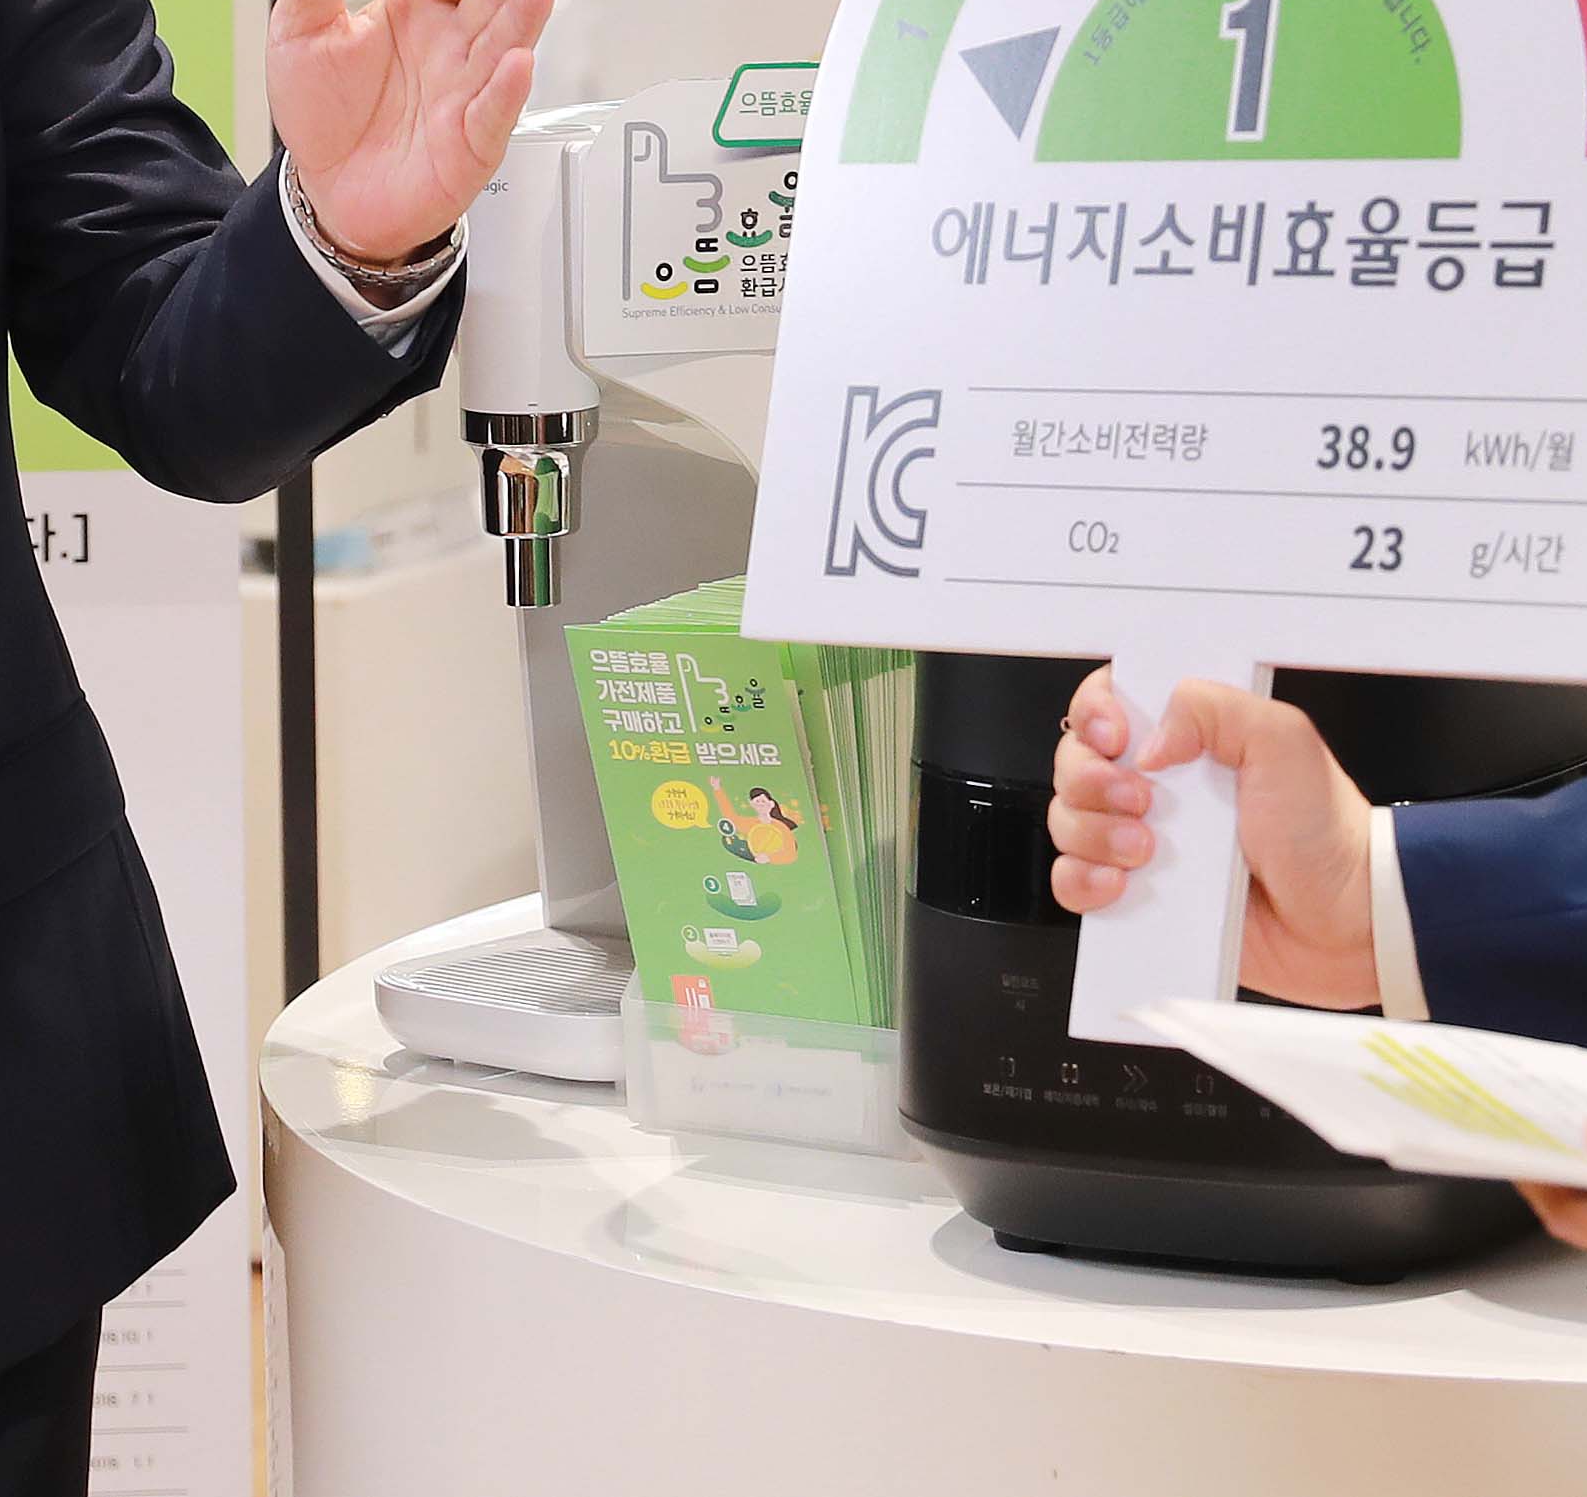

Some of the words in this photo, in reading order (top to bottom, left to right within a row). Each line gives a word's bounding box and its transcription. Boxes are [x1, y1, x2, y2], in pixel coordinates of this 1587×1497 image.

[482, 178, 510, 196] agic
[931, 194, 1556, 292] 에너지소비효율등급
[622, 307, 667, 319] Supreme
[669, 306, 716, 318] Efficiency
[729, 305, 750, 315] Low
[751, 303, 782, 315] Consu
[1012, 419, 1208, 461] 월간소비전력량
[1316, 424, 1416, 471] 38.9
[1464, 429, 1574, 472] kWh/월
[1350, 525, 1404, 571] 23
[1470, 531, 1564, 579] g/시간
[589, 649, 671, 675] 으뜸효율
[595, 679, 677, 705] 가전제품
[601, 709, 685, 735] 구매하고
[608, 738, 692, 765] 10%환급
[694, 742, 782, 766] 받으세요
